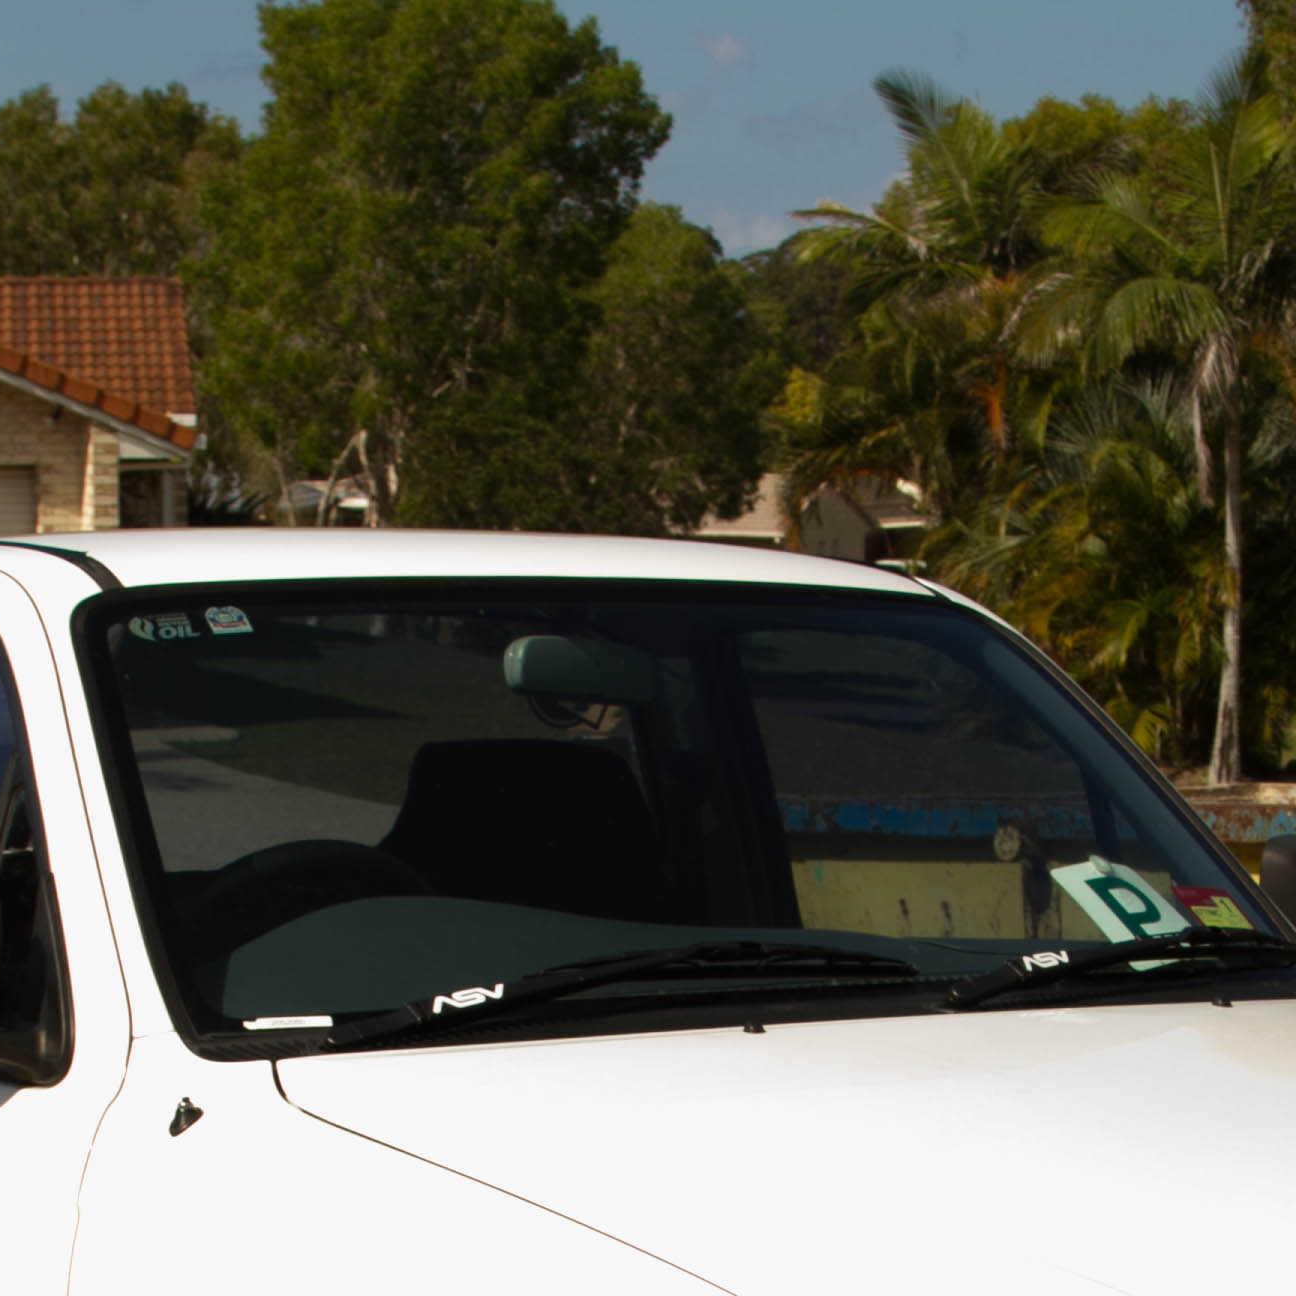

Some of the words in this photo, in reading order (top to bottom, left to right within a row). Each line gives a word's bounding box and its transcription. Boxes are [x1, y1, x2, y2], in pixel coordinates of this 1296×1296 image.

[159, 625, 201, 639] OIL
[1084, 877, 1162, 941] P
[1022, 949, 1069, 971] ASV
[431, 982, 504, 1014] ASV
